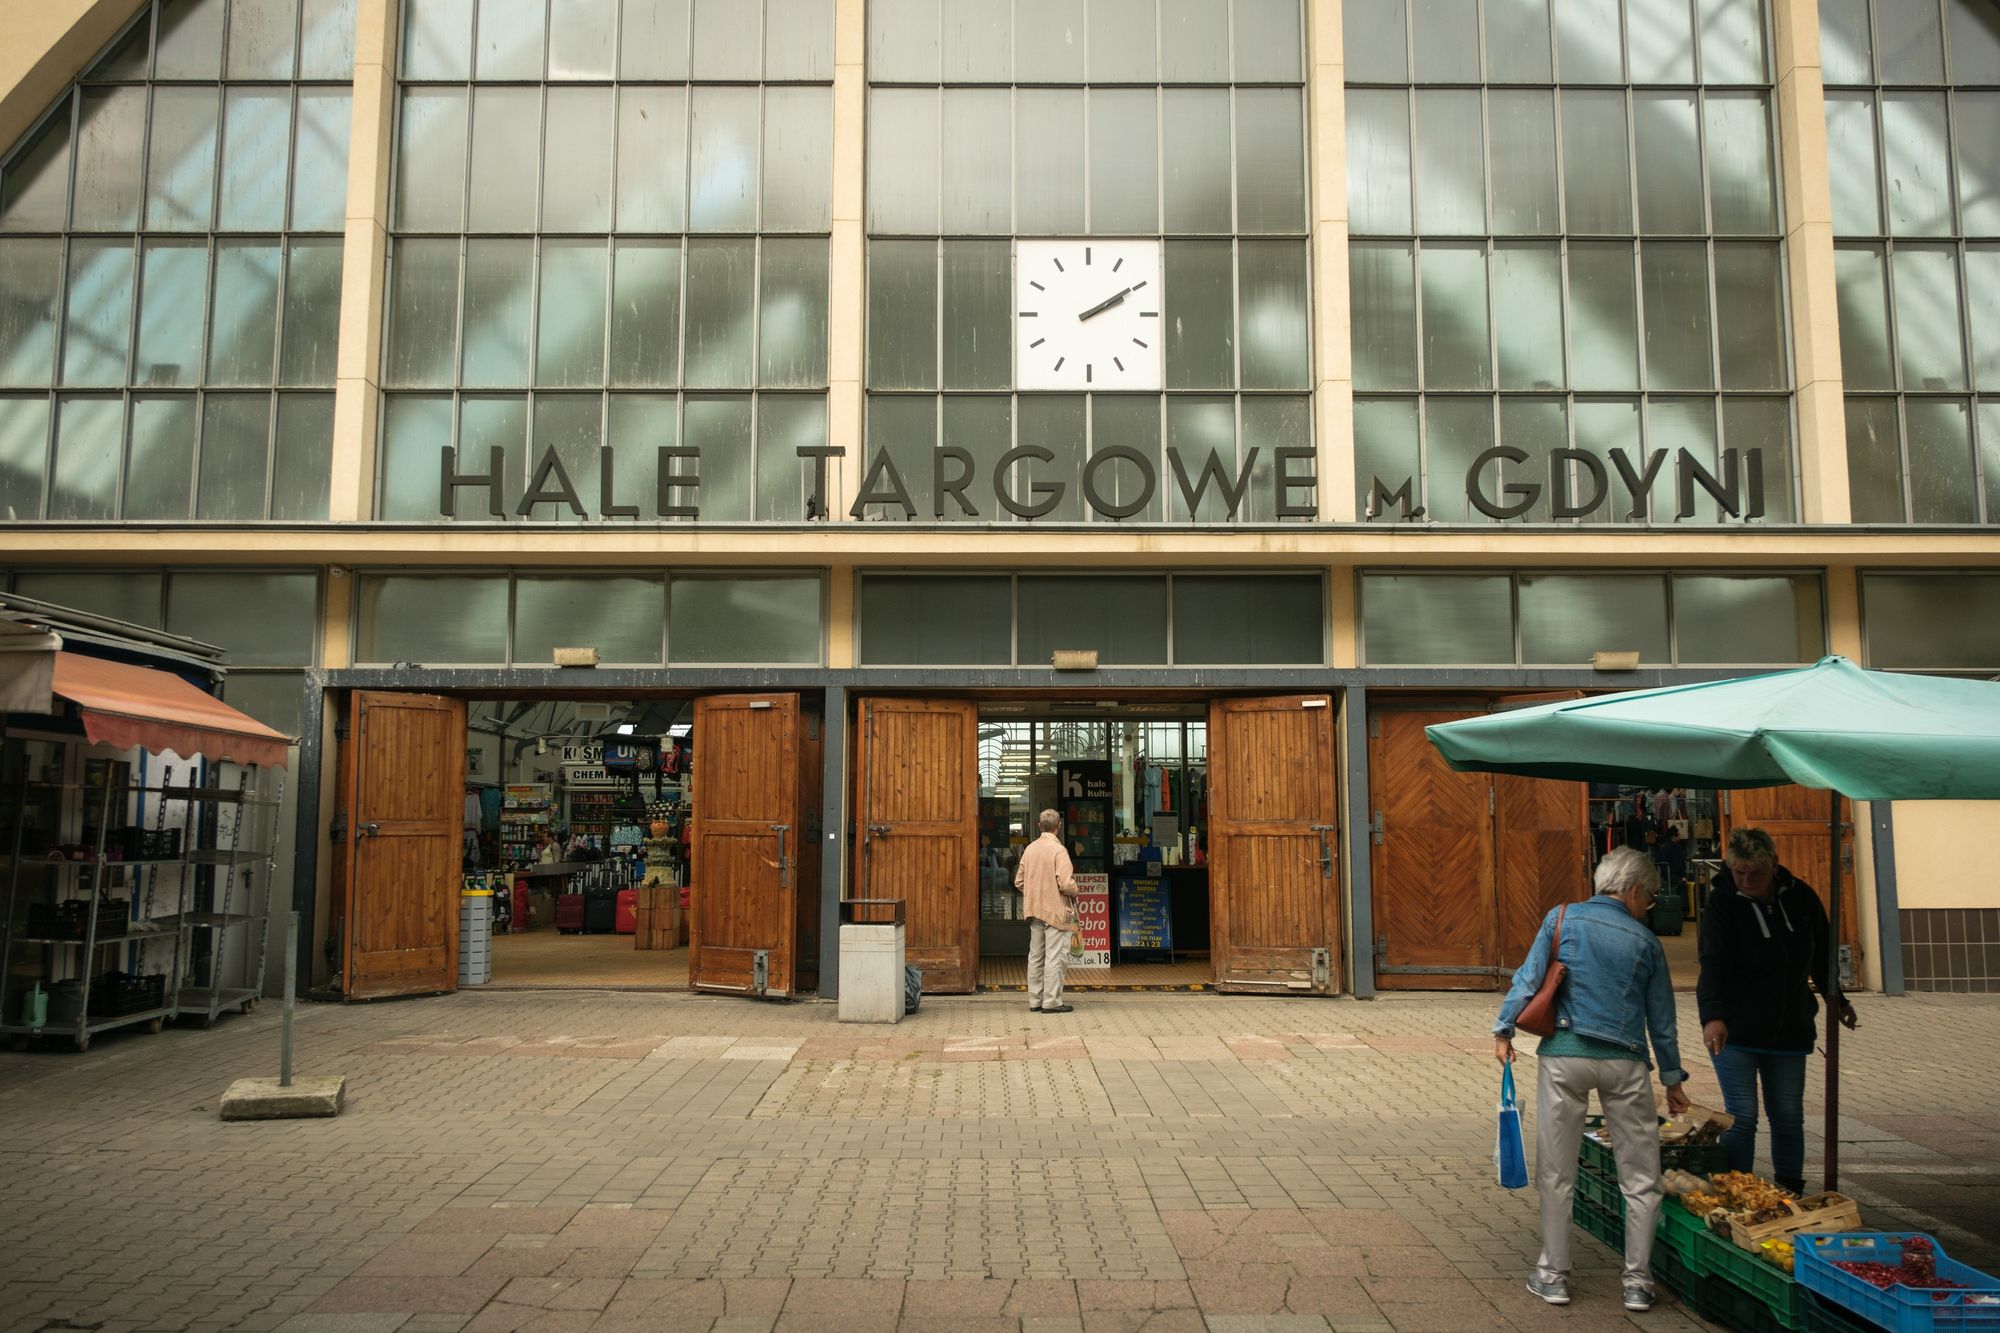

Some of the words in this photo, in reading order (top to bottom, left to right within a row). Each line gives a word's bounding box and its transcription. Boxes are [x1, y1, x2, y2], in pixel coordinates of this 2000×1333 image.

[441, 444, 700, 517] HALE
[796, 444, 1318, 518] TARGOWE
[1465, 445, 1763, 519] GDYNI
[1077, 885, 1096, 893] ENY
[1076, 896, 1106, 914] oto
[1079, 916, 1106, 931] ebro
[1083, 936, 1106, 948] sztyn
[1151, 940, 1161, 948] 23
[1097, 952, 1110, 965] 18
